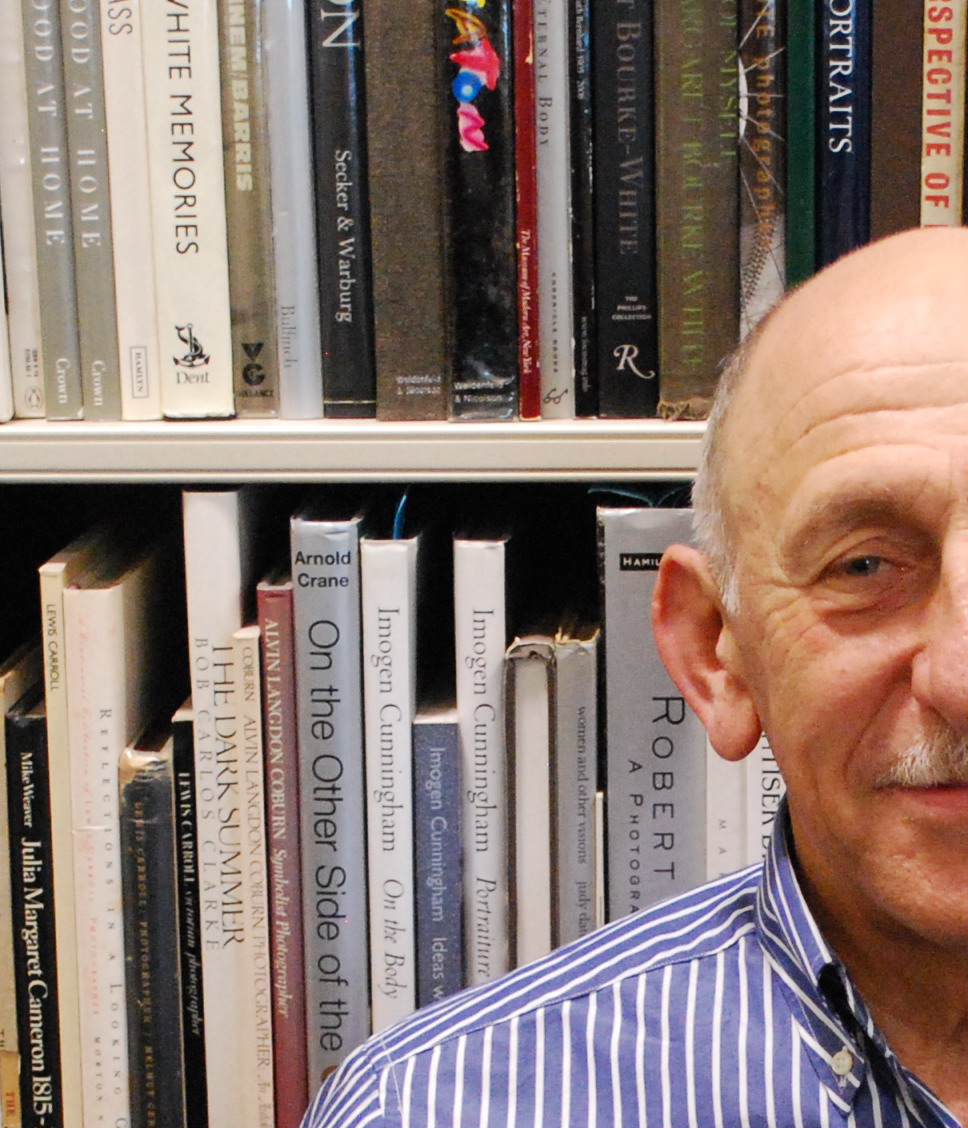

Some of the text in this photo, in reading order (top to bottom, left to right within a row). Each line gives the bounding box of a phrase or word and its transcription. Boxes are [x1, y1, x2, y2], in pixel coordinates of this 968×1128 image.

[73, 84, 94, 120] AT
[538, 96, 556, 148] BODY
[616, 23, 645, 255] BOURKE-WHITE
[923, 0, 953, 208] SPECTIVE OF
[37, 82, 65, 247] AT HOME
[77, 149, 101, 249] HOME
[169, 95, 200, 255] MEMORIES
[335, 150, 355, 324] Secker & Warburg
[176, 370, 210, 385] Dent
[281, 304, 298, 369] Bulfinch
[55, 357, 70, 405] Crown
[91, 360, 106, 407] Crown
[294, 551, 351, 566] Arnold
[297, 572, 350, 588] Crane
[45, 604, 60, 692] LEWIS CARROLL
[242, 646, 256, 701] COBURN
[20, 752, 34, 783] Mike
[243, 715, 258, 764] ALVIN
[628, 759, 644, 774] A
[22, 783, 35, 828] Weaver
[99, 708, 115, 886] REFLECTIONS
[177, 771, 192, 817] LEWIS
[195, 637, 220, 951] BOB CARLOS CLARKE
[212, 645, 245, 947] THE DARK SUMMER
[245, 769, 261, 855] LANGDON
[264, 618, 292, 1017] ALVIN LANGDON COBURN Symbolist Photographer
[370, 607, 406, 999] Imogen Cunningham On the Body
[465, 608, 498, 977] Imogen Cunningham Portraiture
[575, 706, 590, 909] women and other visions judy
[652, 696, 686, 881] ROBERT
[21, 837, 43, 882] Julia
[180, 821, 195, 884] CARROLL
[308, 619, 350, 1052] On the Other Side of the
[425, 747, 447, 979] Imogen Cunningham Ideas
[21, 888, 44, 978] Margaret
[107, 908, 117, 931] IN
[249, 859, 266, 929] COBURN
[109, 952, 117, 962] A
[183, 951, 202, 1035] photographer
[28, 979, 48, 1072] Cameron
[109, 983, 123, 1096] LOOKING
